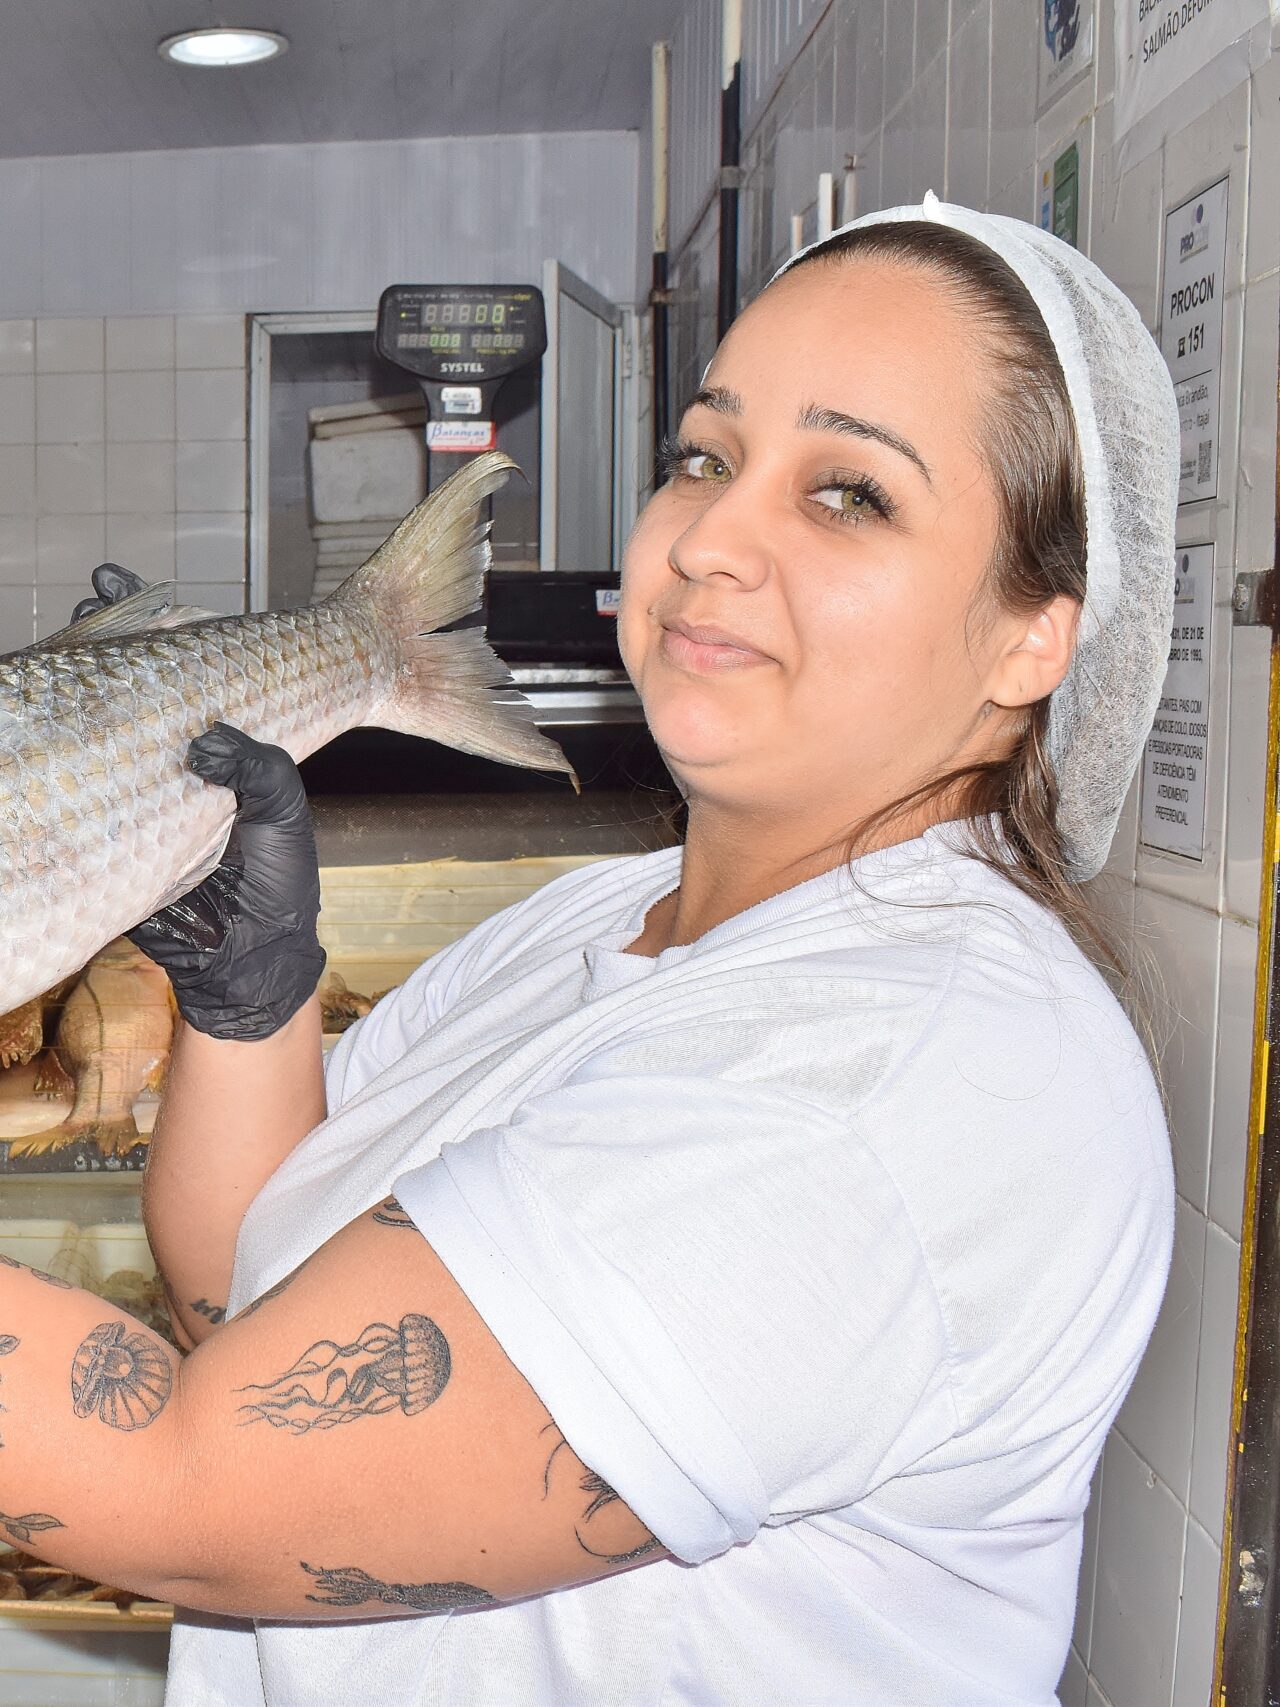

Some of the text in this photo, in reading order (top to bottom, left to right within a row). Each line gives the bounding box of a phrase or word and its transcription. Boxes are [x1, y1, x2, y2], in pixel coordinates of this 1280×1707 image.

[1143, 11, 1180, 63] SALMÃO
[1170, 273, 1214, 319] PROCON
[1188, 322, 1205, 353] 151
[440, 362, 484, 373] SYSTEL
[1182, 627, 1189, 640] DE
[1197, 627, 1204, 640] DE
[1181, 648, 1189, 661] DE
[1191, 700, 1202, 713] COM
[1152, 740, 1172, 755] PESSOAS
[1172, 742, 1203, 760] PORTADORAS
[1152, 761, 1159, 775] DE
